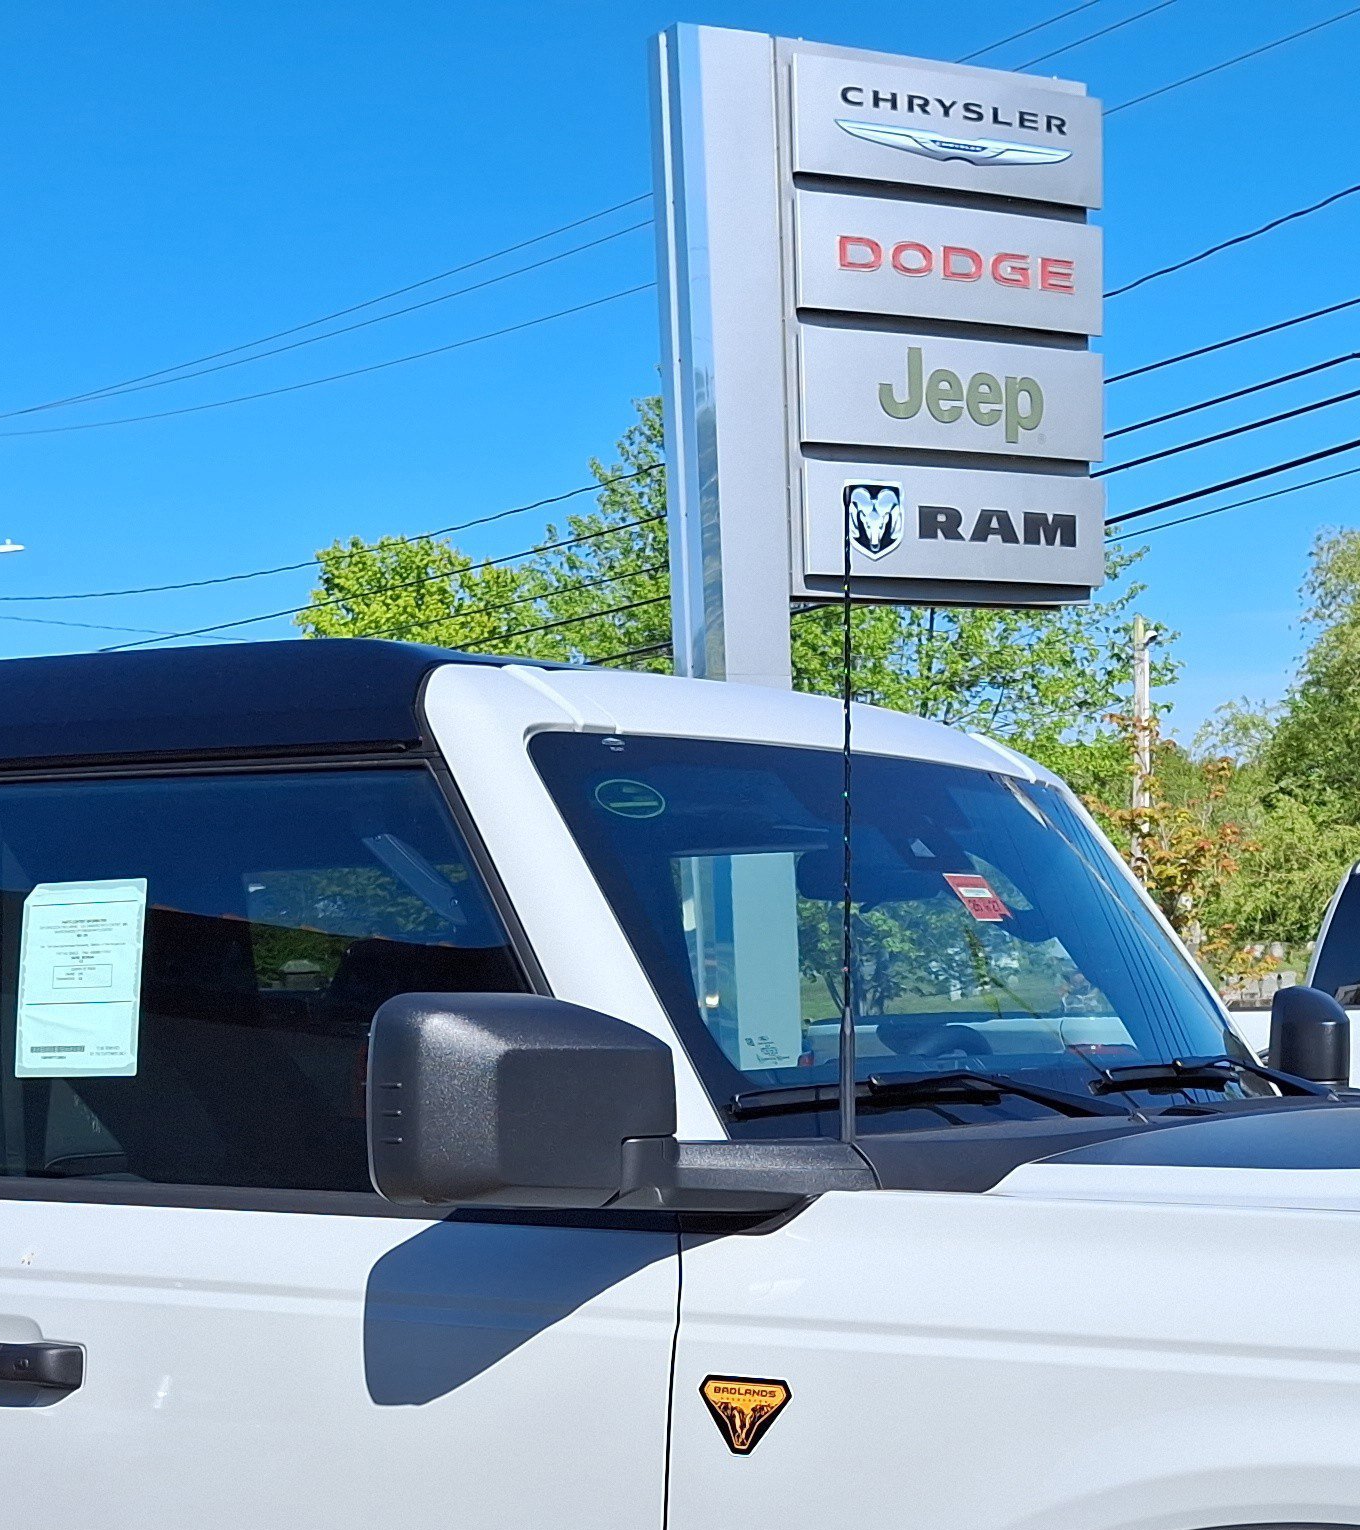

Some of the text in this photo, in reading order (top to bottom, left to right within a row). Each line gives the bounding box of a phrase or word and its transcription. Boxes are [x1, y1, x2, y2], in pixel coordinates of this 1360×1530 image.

[840, 86, 1068, 136] CHRYSLER
[837, 235, 1076, 295] DODGE
[878, 346, 1044, 444] Jeep
[917, 505, 1077, 549] RAM
[713, 1386, 777, 1398] BADLANDS
